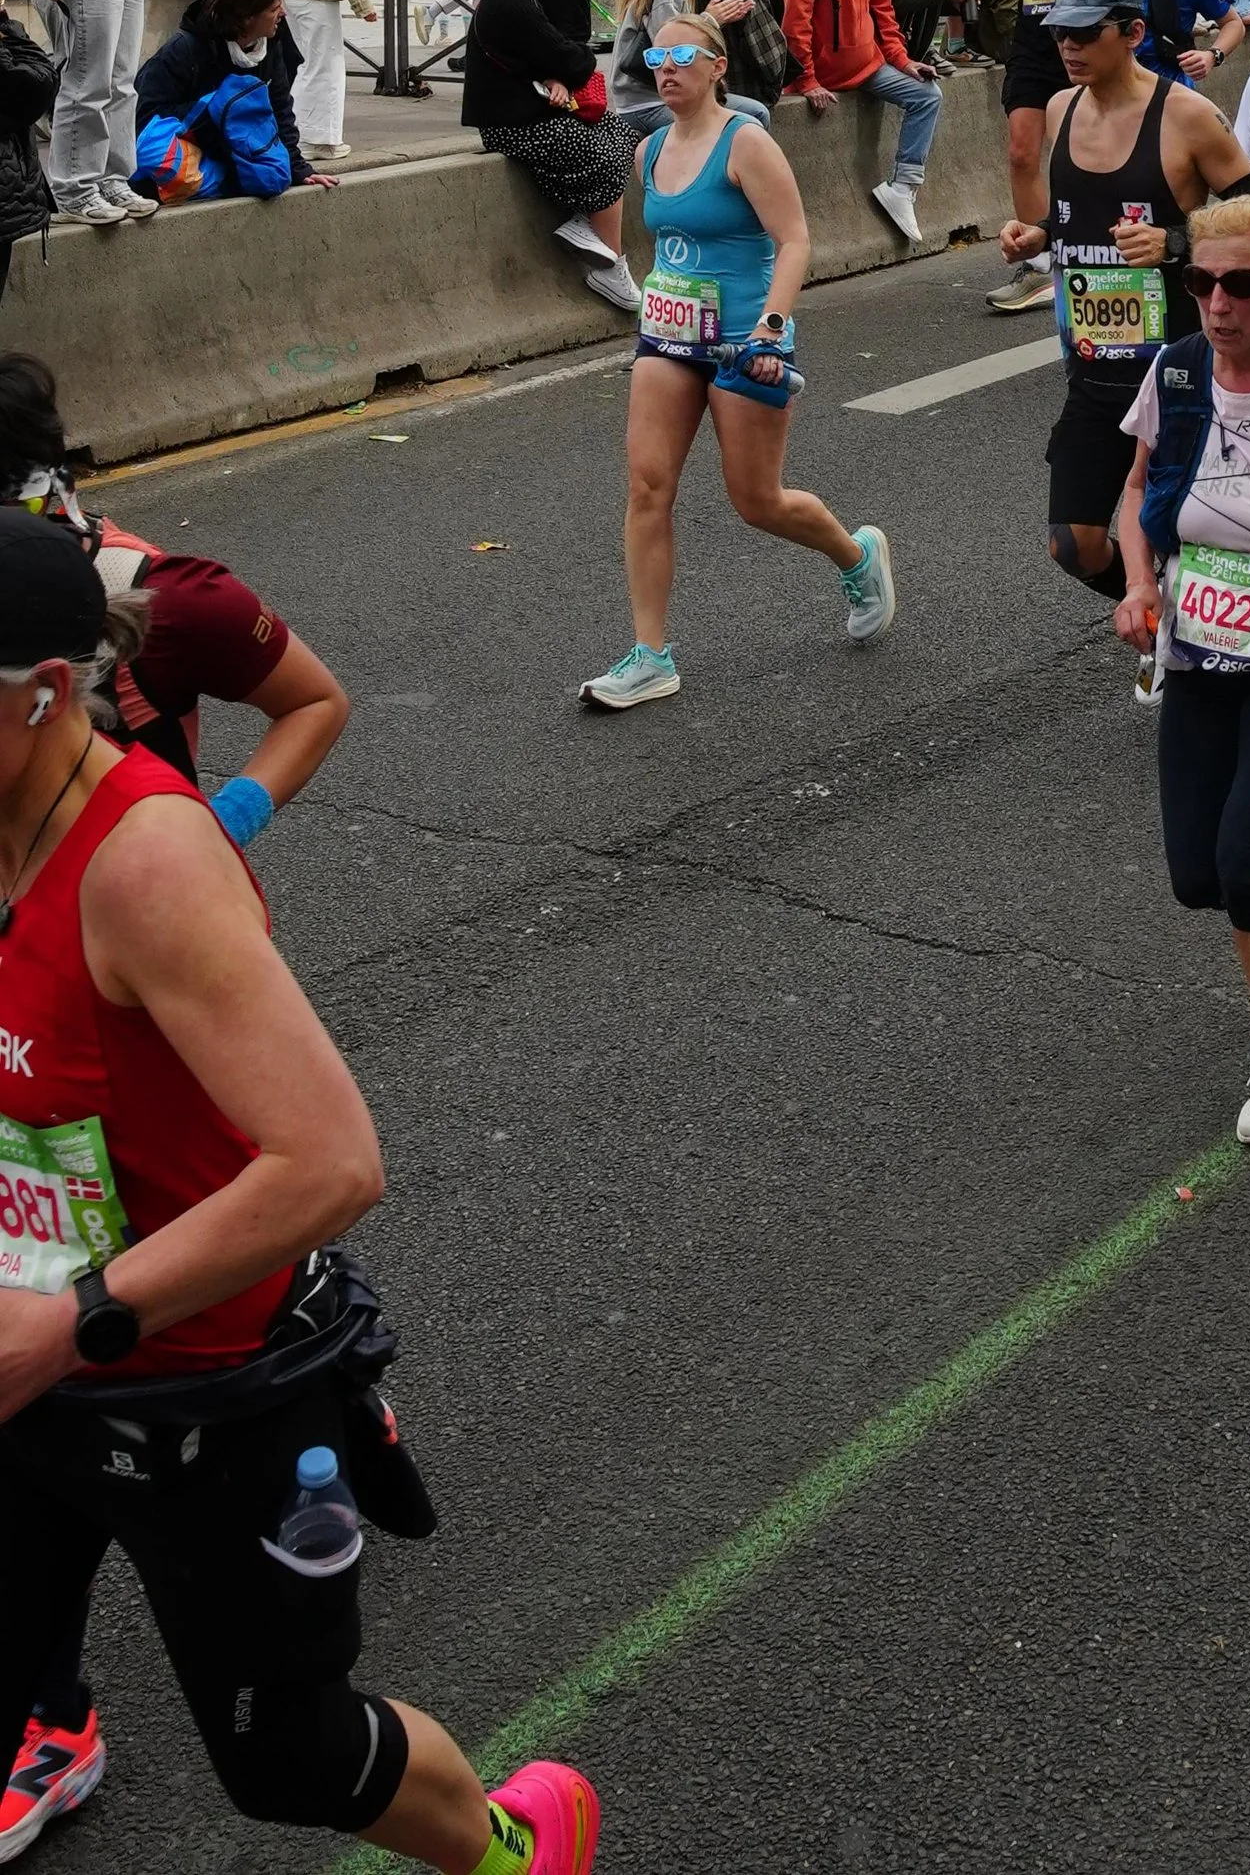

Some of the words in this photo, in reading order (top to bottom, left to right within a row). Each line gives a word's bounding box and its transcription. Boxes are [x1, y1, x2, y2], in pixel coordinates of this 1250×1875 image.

[655, 272, 692, 288] Schneider
[645, 294, 694, 328] 39901
[704, 311, 715, 340] 3H45
[1072, 297, 1141, 328] 50890
[1087, 330, 1107, 340] YONG
[1107, 330, 1125, 340] SOO
[1203, 632, 1240, 650] VALÉRIE
[235, 1687, 254, 1733] FUSION
